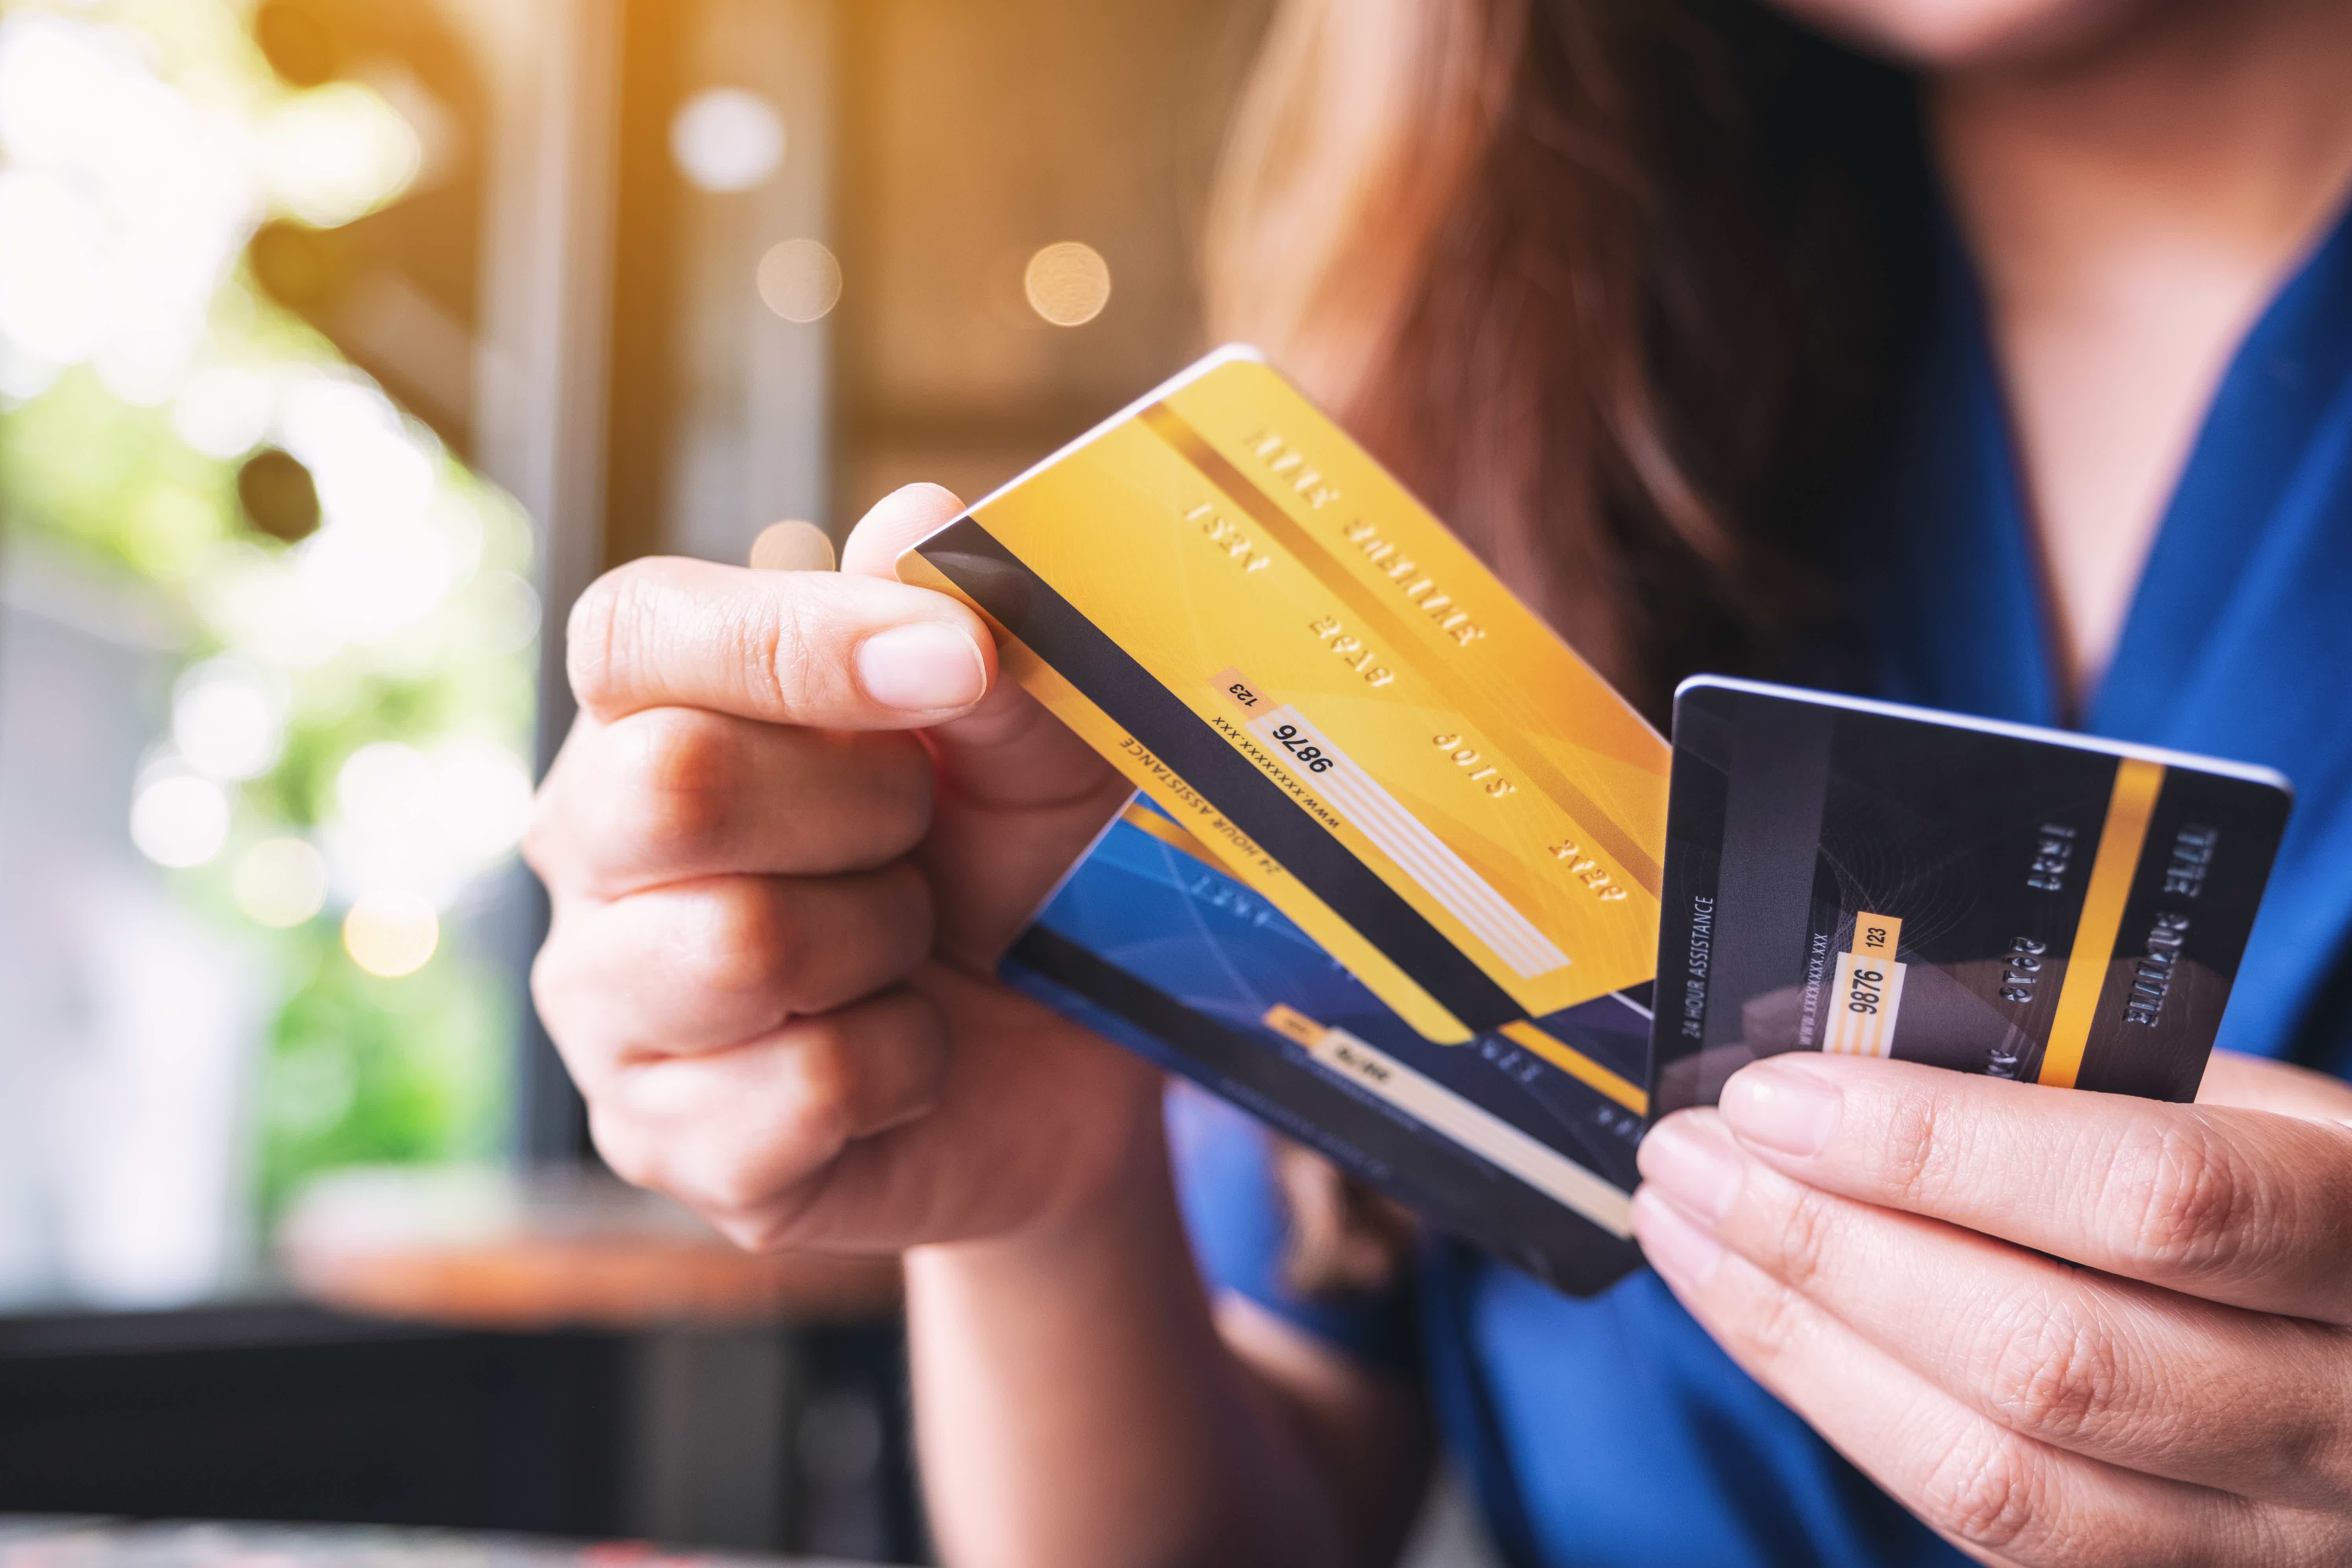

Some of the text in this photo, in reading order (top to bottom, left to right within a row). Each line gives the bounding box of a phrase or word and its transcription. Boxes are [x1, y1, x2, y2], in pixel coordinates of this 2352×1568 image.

[1229, 683, 1257, 707] 123
[1272, 724, 1333, 774] 9876
[1119, 737, 1213, 816] ASSISTANCE
[1212, 818, 1259, 855] HOUR
[1865, 927, 1887, 948] 123
[1681, 896, 1713, 1040] 24 HOUR ASSISTANCE
[1848, 969, 1883, 1014] 9876
